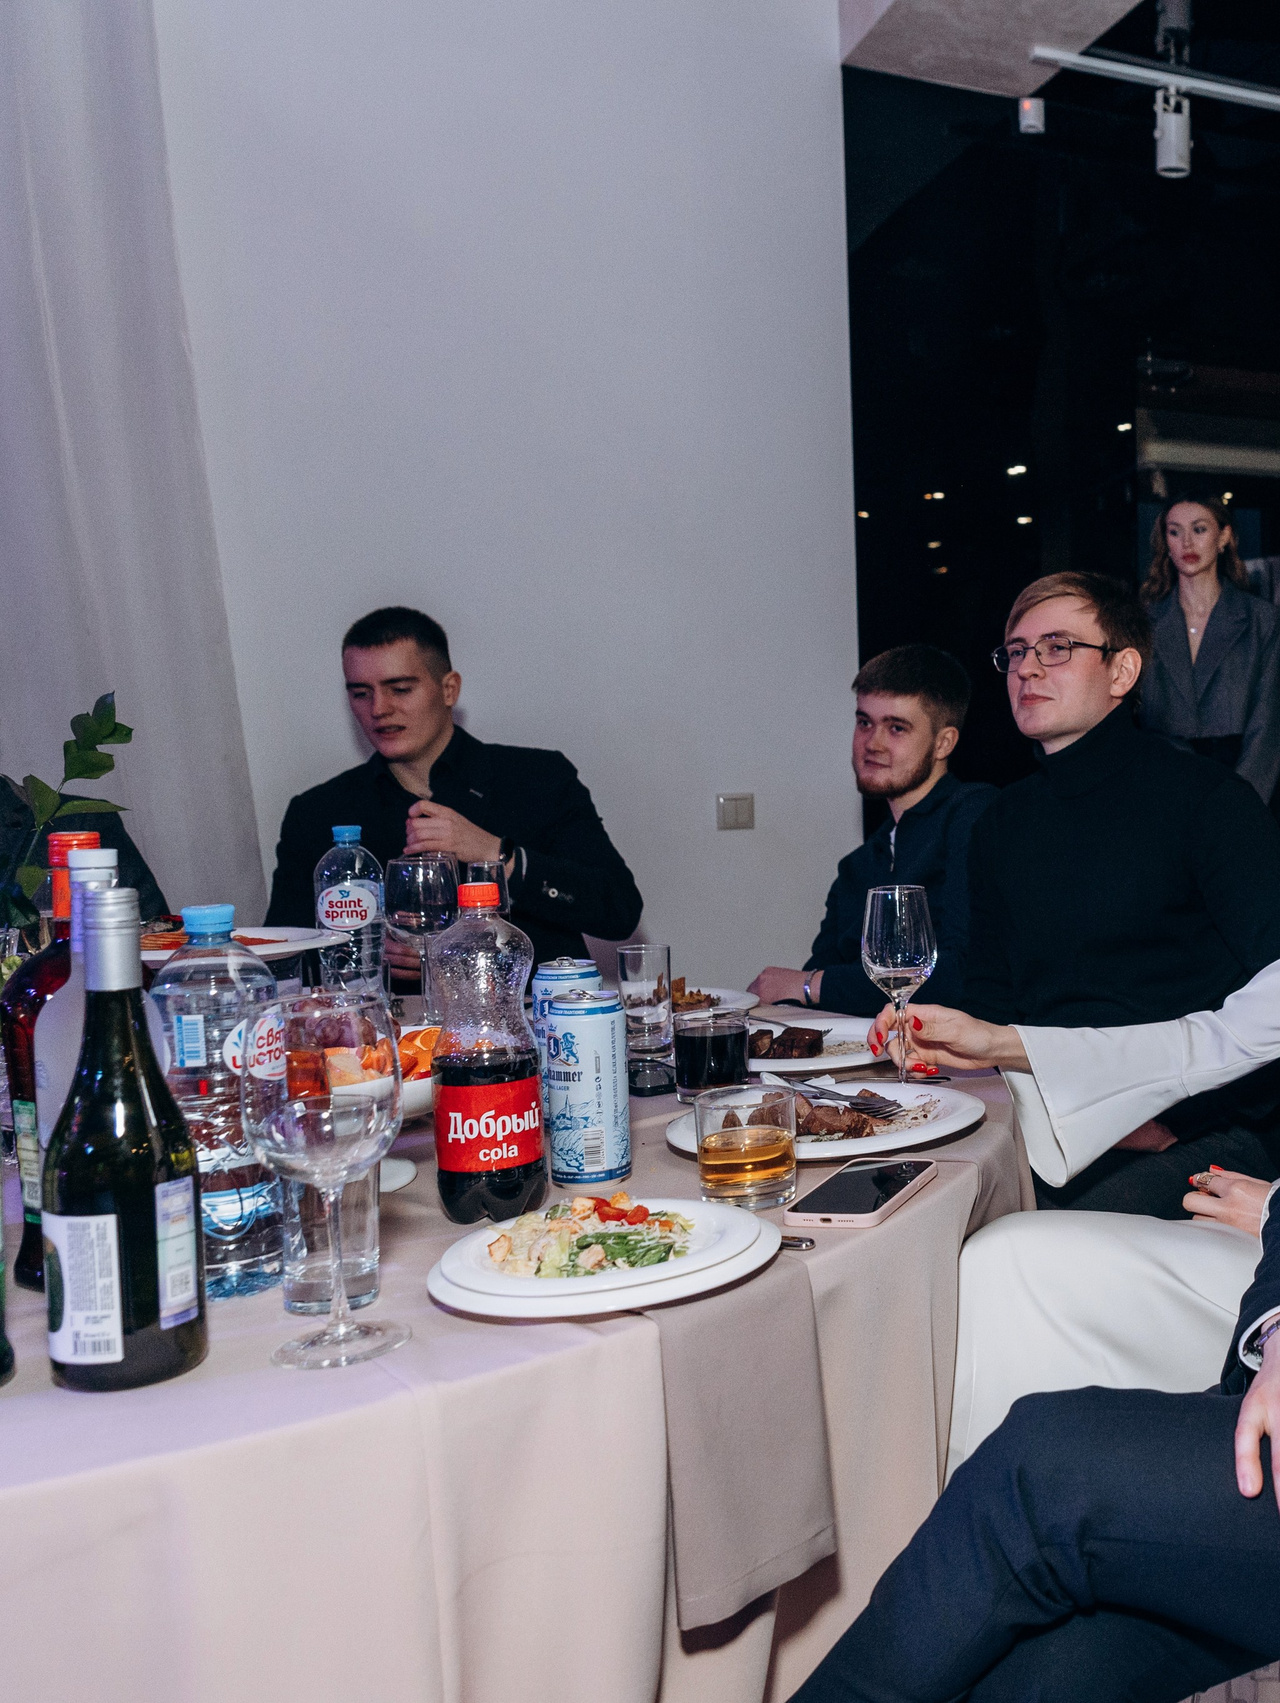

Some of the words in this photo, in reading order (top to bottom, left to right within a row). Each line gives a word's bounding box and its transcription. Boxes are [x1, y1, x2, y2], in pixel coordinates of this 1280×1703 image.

[328, 898, 363, 909] saint
[325, 909, 368, 922] spring
[448, 1101, 539, 1144] Добрый
[479, 1142, 518, 1162] cola
